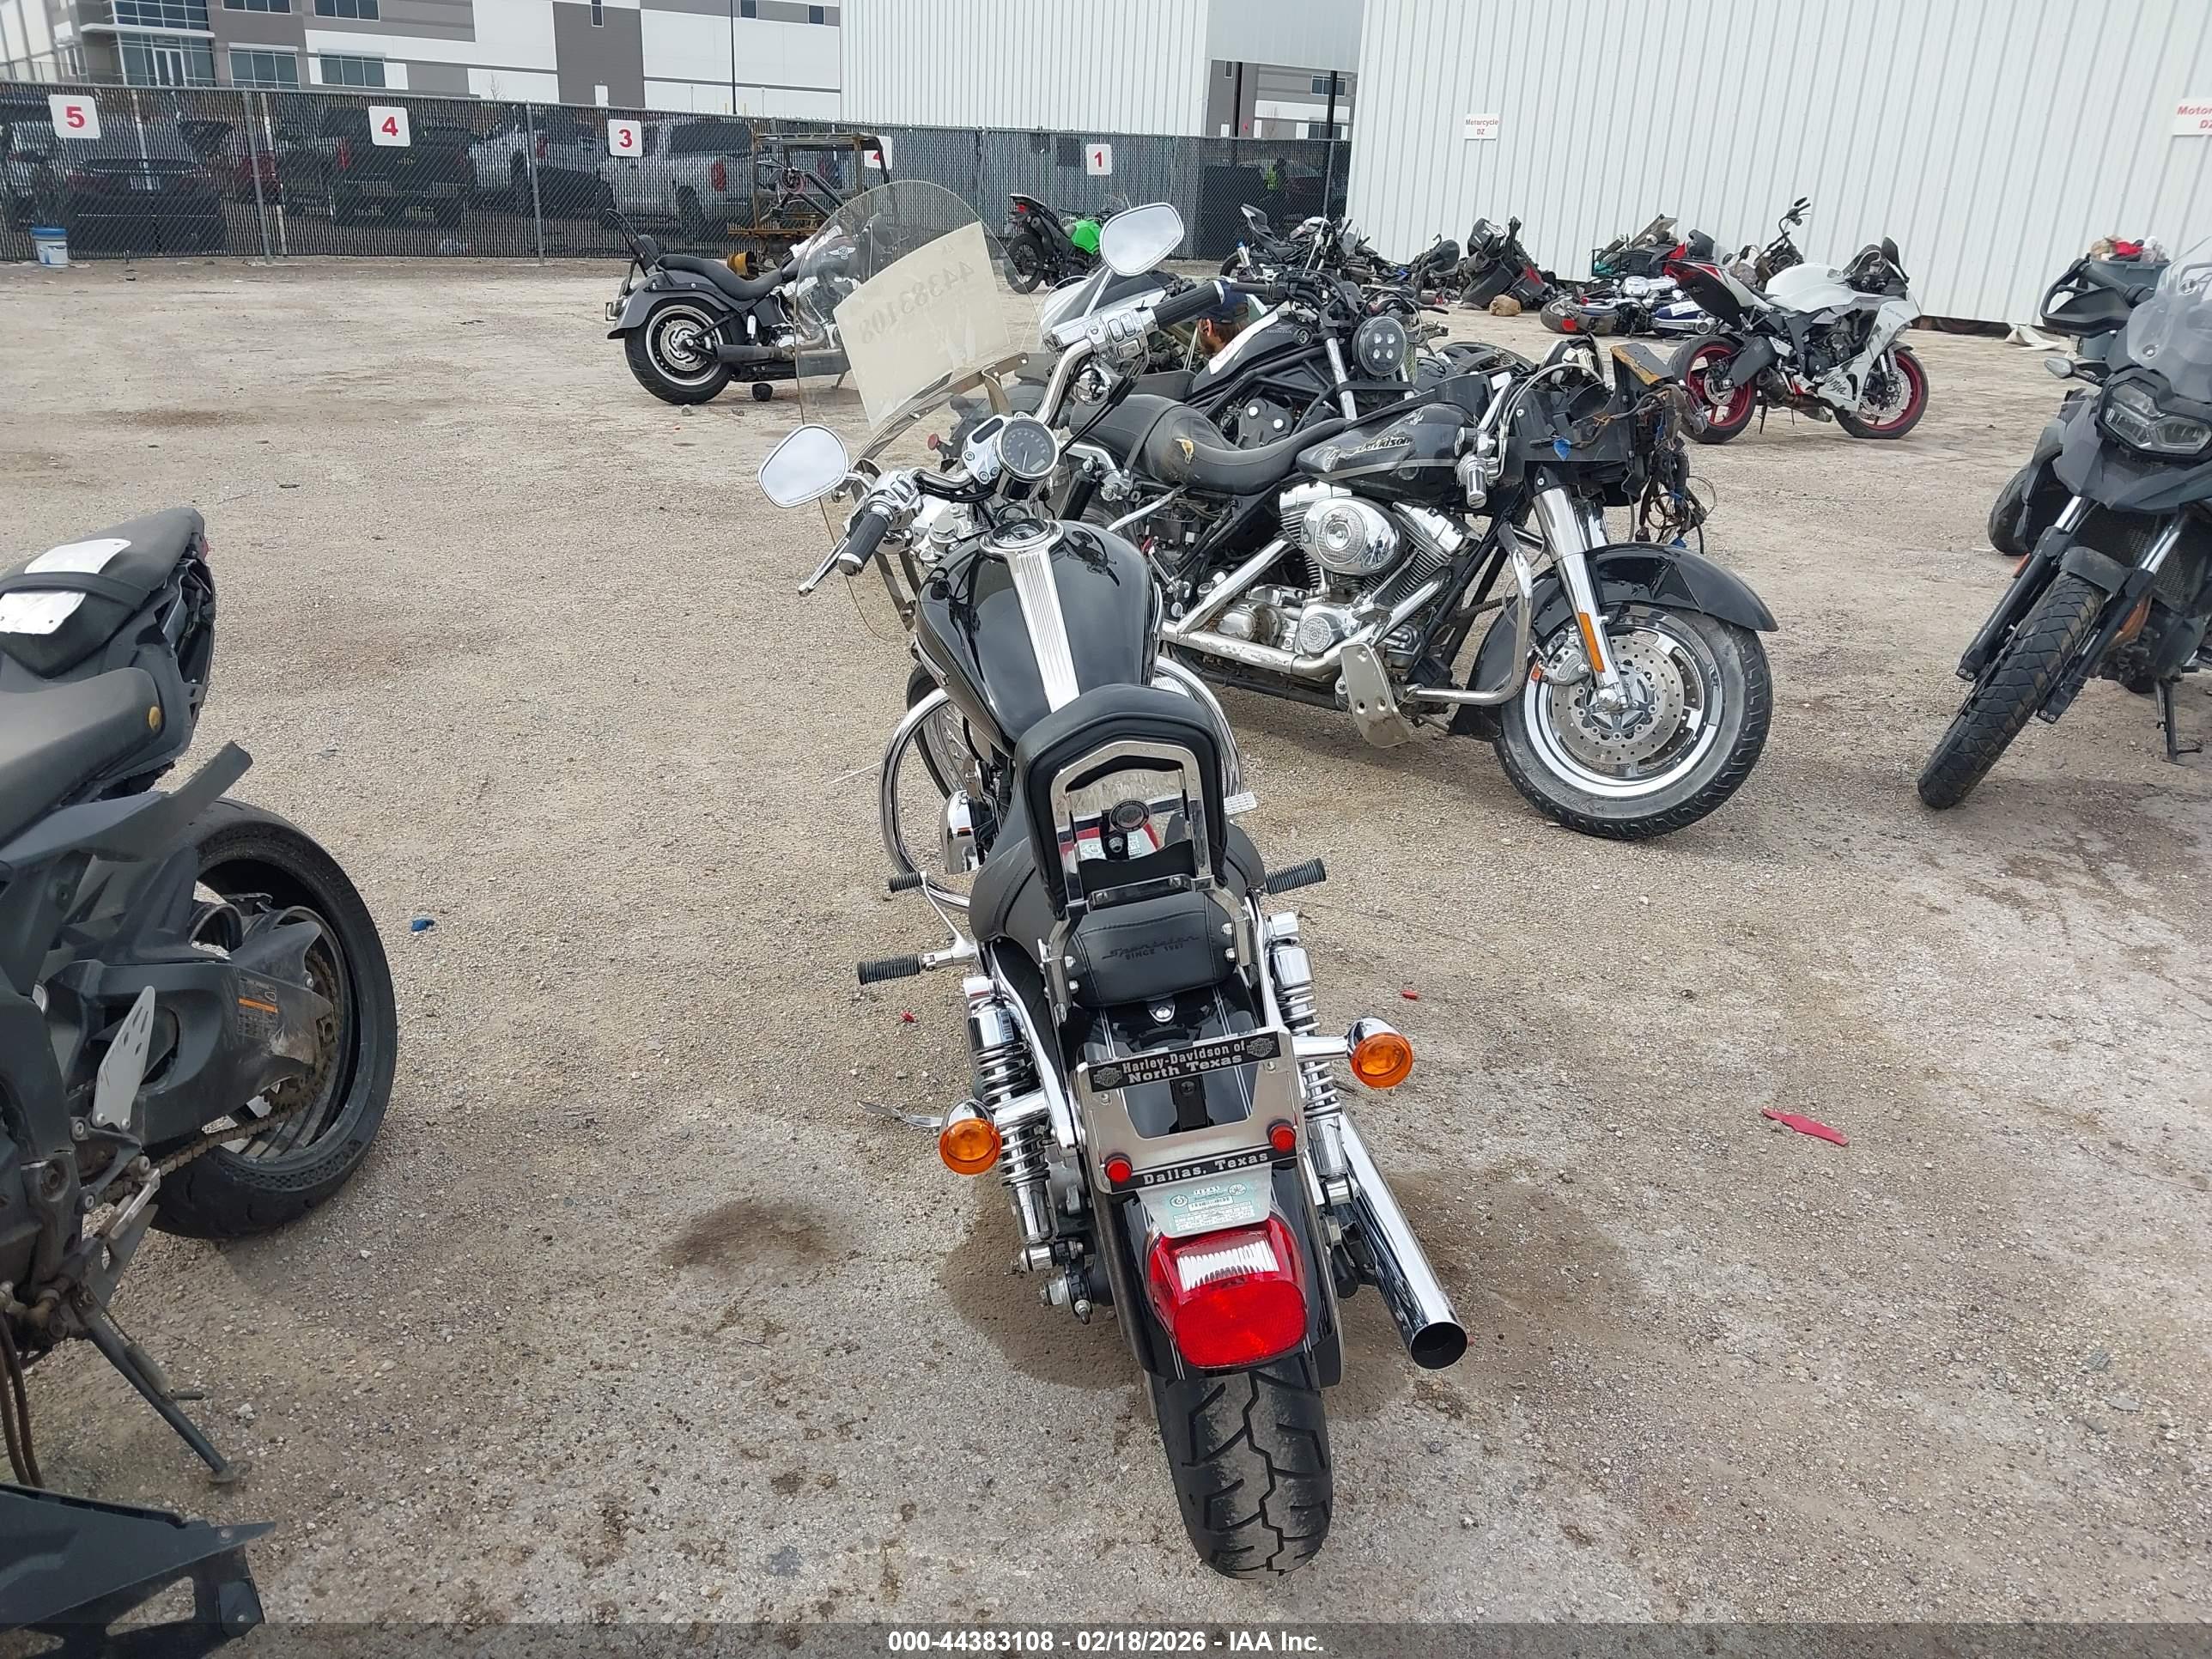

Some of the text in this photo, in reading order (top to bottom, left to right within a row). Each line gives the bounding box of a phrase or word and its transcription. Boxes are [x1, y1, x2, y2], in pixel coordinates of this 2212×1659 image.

[66, 106, 85, 128] 5
[382, 116, 398, 137] 4
[1465, 118, 1498, 127] Motorcycle
[618, 129, 633, 148] 3
[1094, 151, 1103, 167] 1
[1121, 1043, 1230, 1074] Harley-Davidson
[1233, 1040, 1246, 1053] of
[1127, 1067, 1180, 1084] North
[1186, 1054, 1243, 1073] Texas
[1214, 1152, 1268, 1170] Texas
